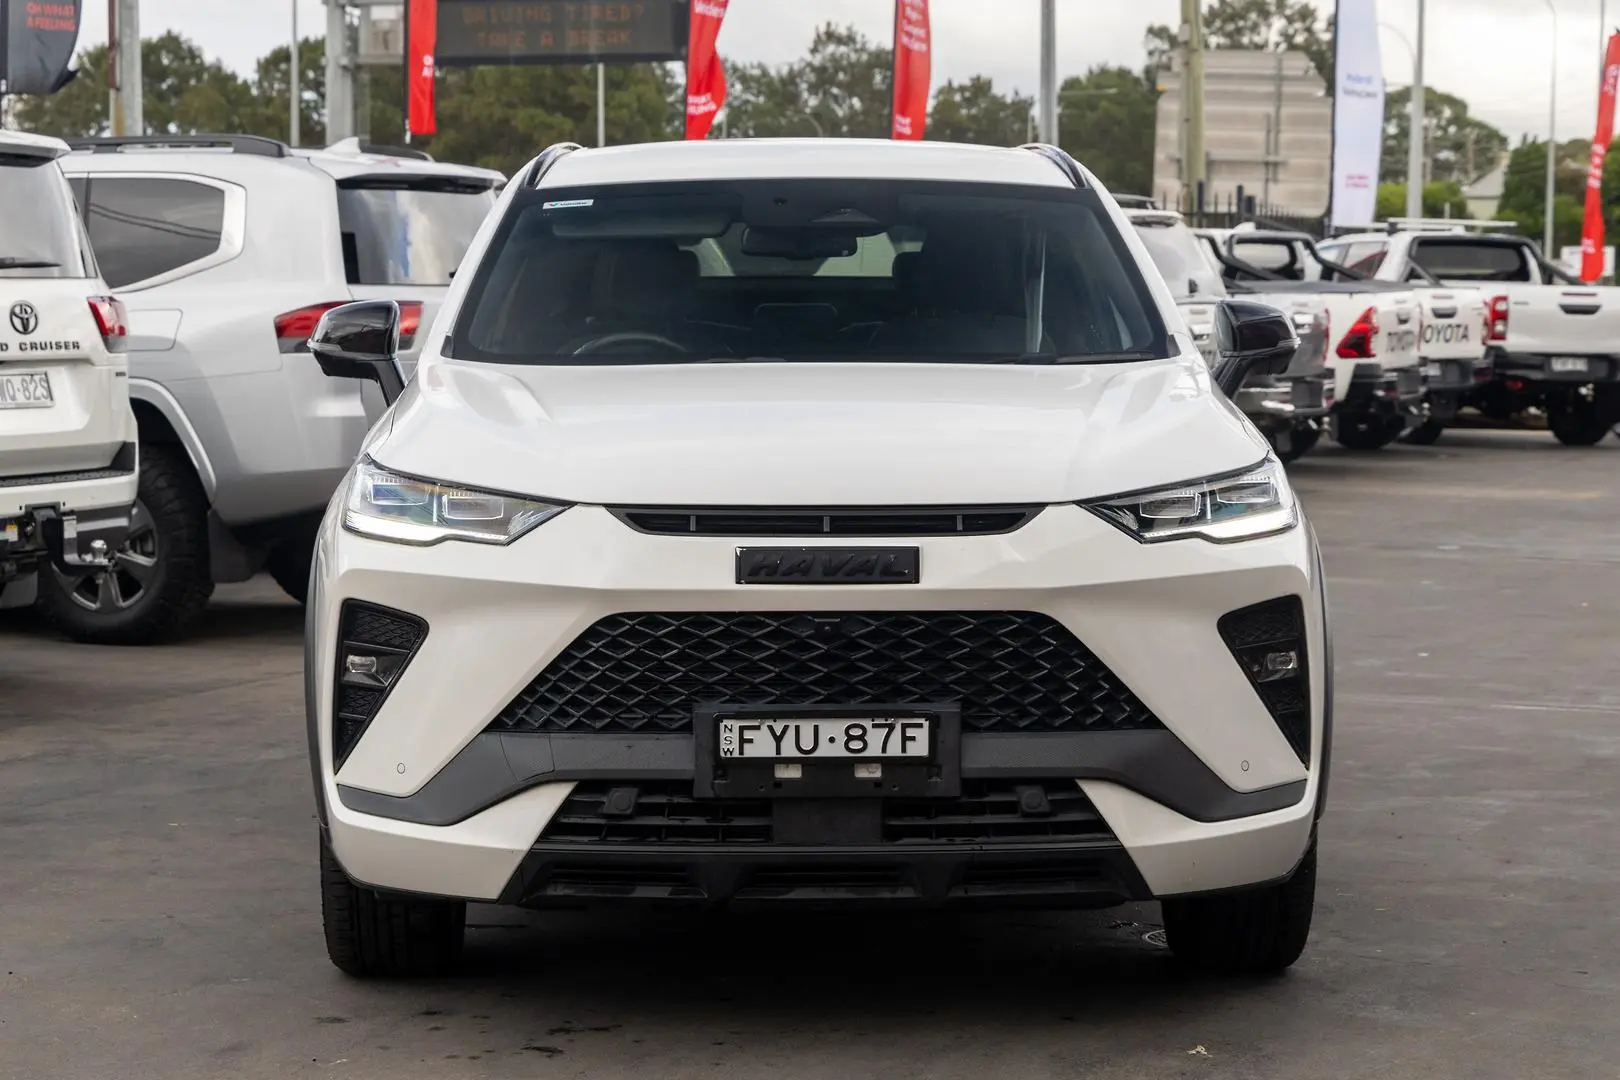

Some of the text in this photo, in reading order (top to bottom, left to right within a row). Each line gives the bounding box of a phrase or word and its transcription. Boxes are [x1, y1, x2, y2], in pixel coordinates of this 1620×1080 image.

[1421, 324, 1469, 343] OYOTA
[19, 341, 81, 352] CRUISER
[747, 553, 907, 577] HAVAL
